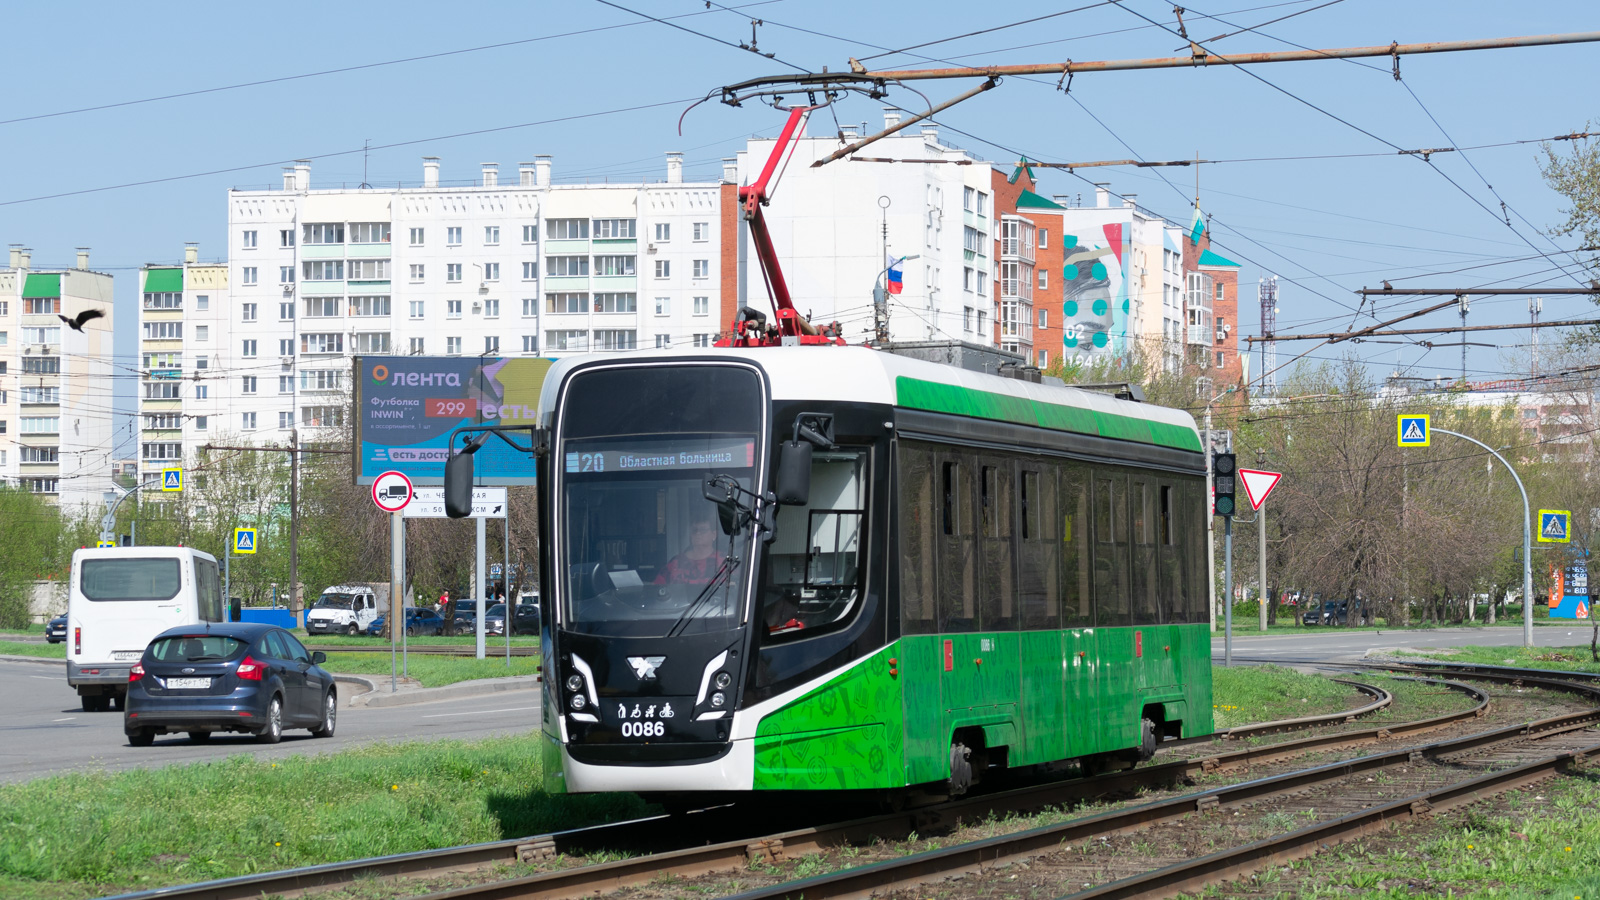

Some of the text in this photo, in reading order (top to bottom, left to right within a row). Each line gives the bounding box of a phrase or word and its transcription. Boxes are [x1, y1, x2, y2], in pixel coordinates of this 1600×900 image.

[1065, 324, 1085, 340] 02
[391, 372, 461, 387] лента
[370, 397, 420, 408] Футболка
[436, 402, 466, 415] 299
[482, 404, 536, 419] есть
[581, 451, 732, 473] 20 Областная больница
[621, 721, 665, 737] 0086
